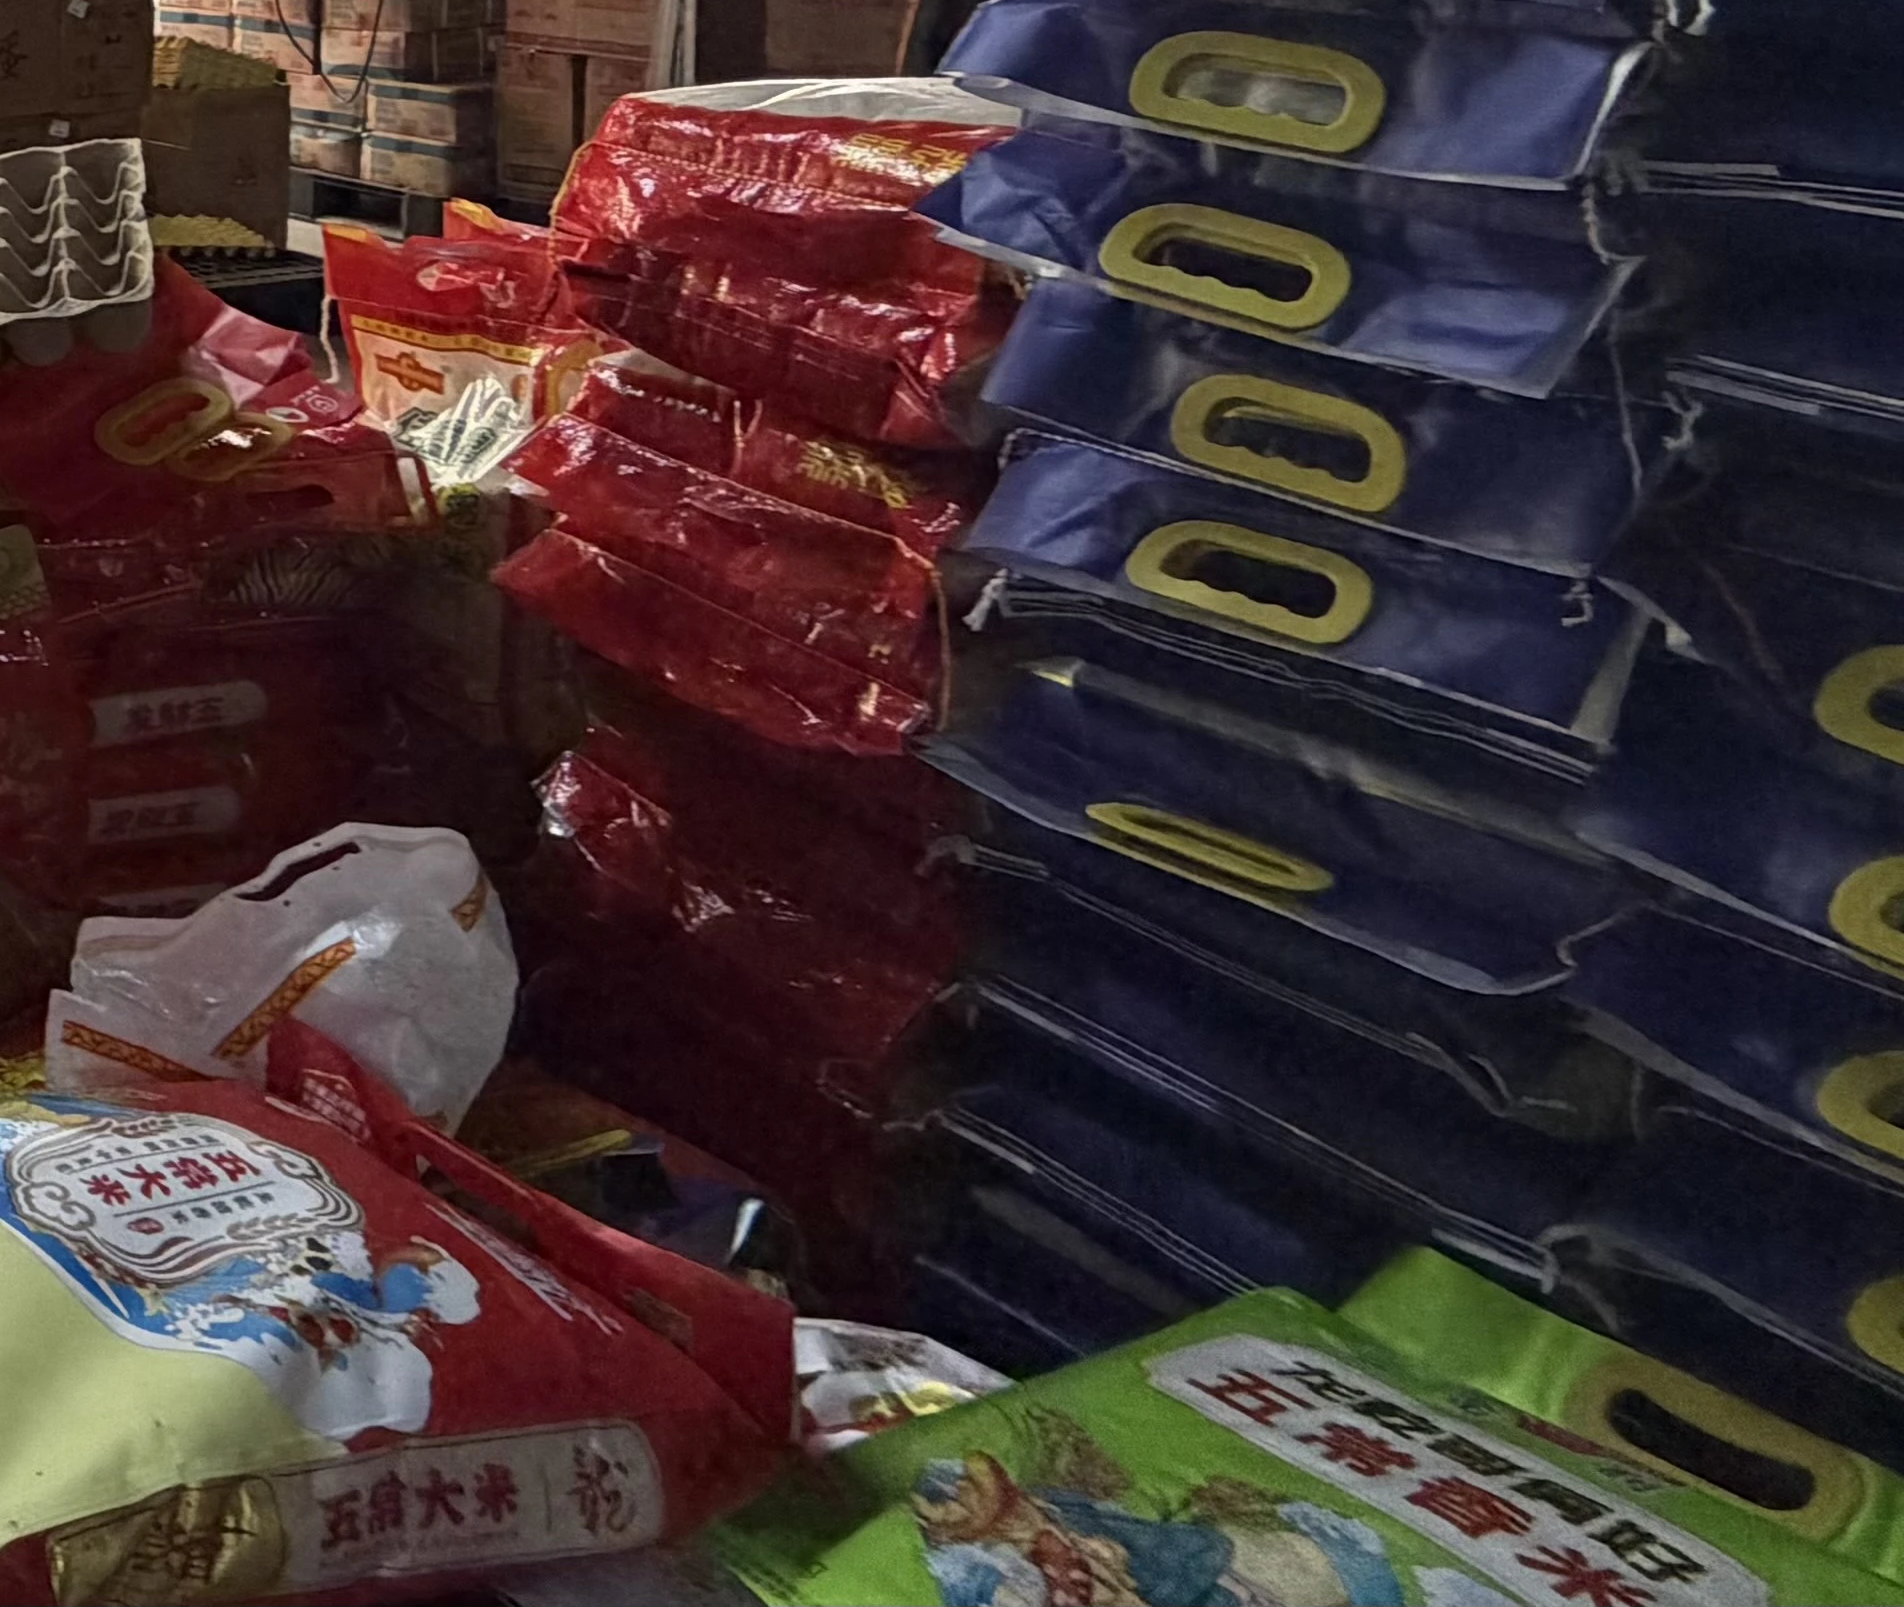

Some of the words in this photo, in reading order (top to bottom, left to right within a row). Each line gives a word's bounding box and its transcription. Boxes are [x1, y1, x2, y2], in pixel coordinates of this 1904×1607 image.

[78, 1149, 263, 1206] 五常大米
[321, 1460, 519, 1552] 五常大米
